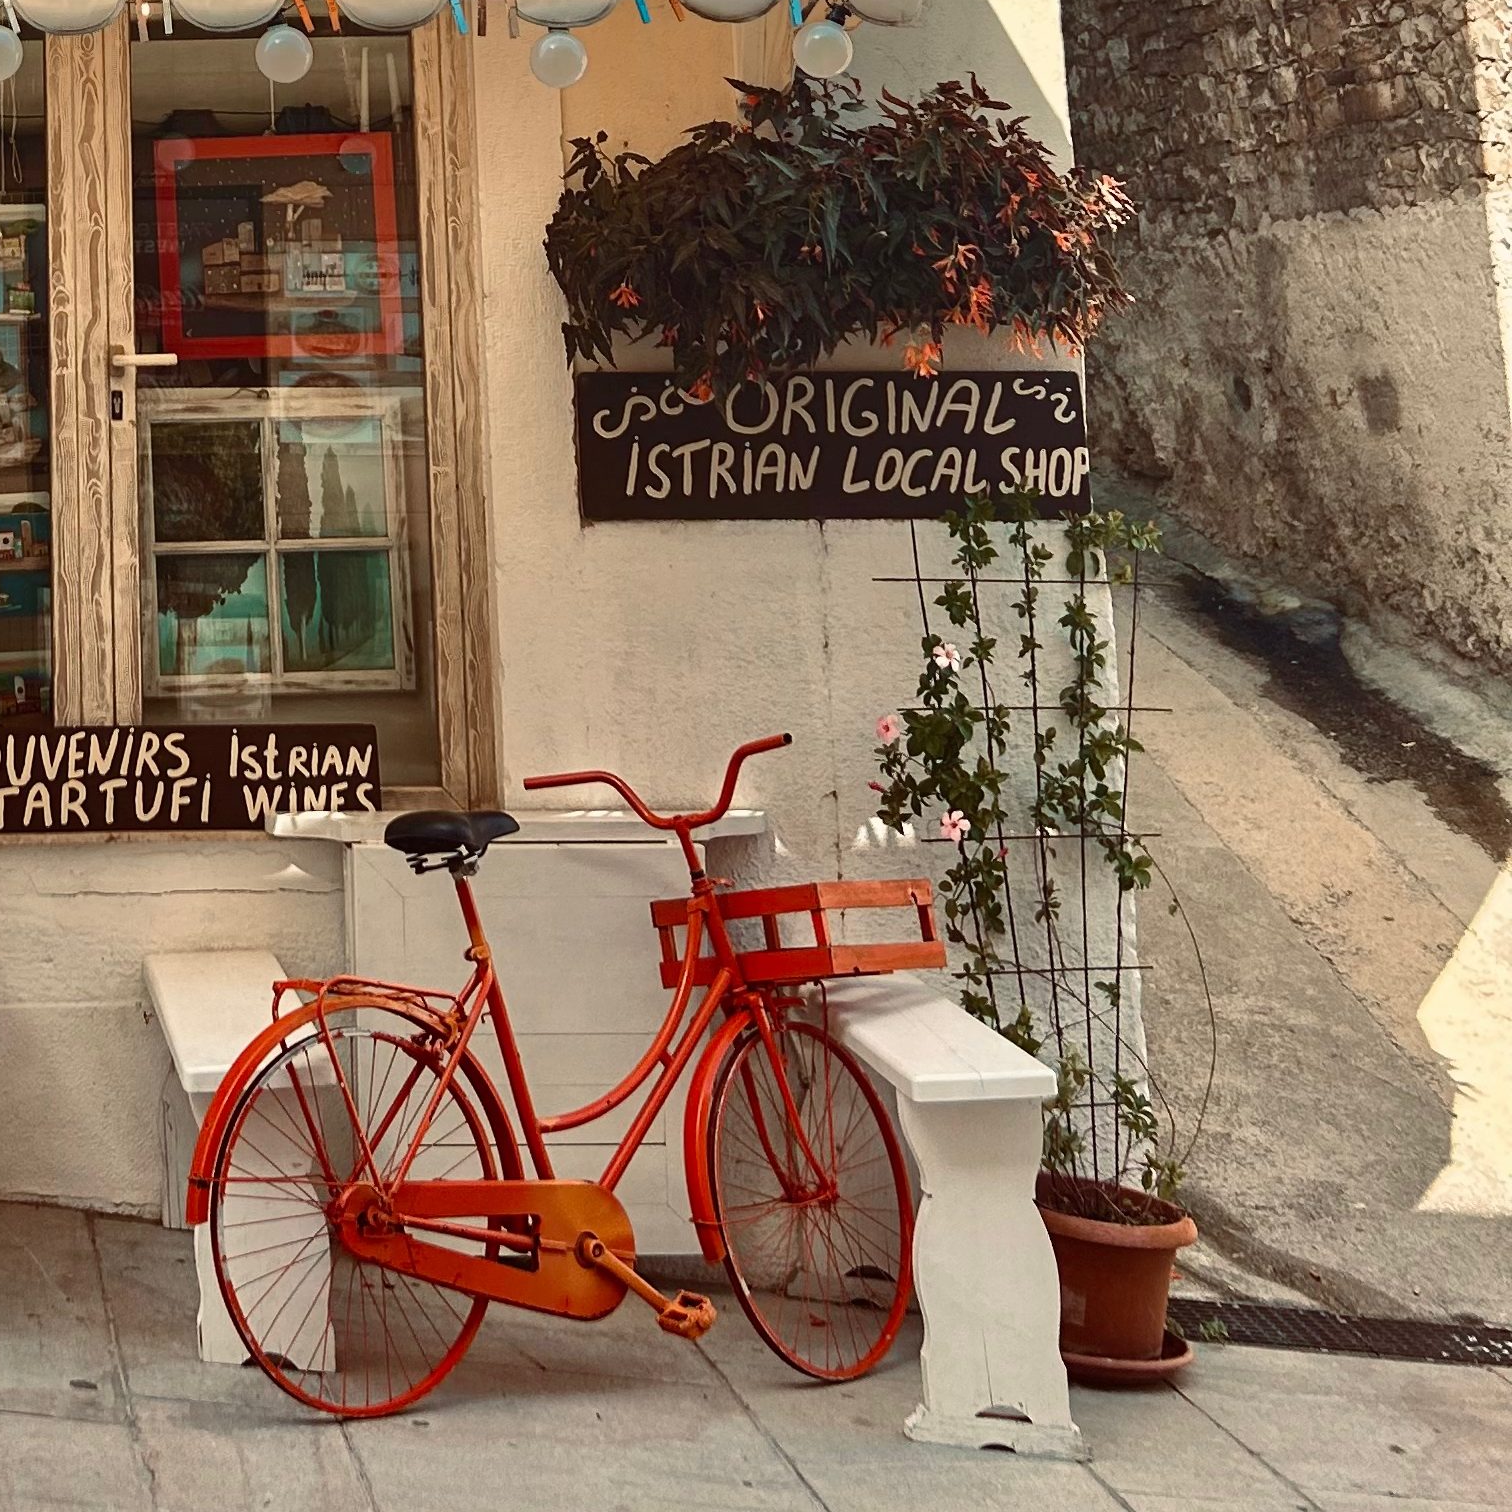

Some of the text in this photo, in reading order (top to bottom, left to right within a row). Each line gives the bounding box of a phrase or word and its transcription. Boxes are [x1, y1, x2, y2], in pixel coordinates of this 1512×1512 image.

[726, 376, 1017, 437] ORIGINAL
[842, 445, 988, 497] LOCAL
[998, 445, 1088, 498] SHOP
